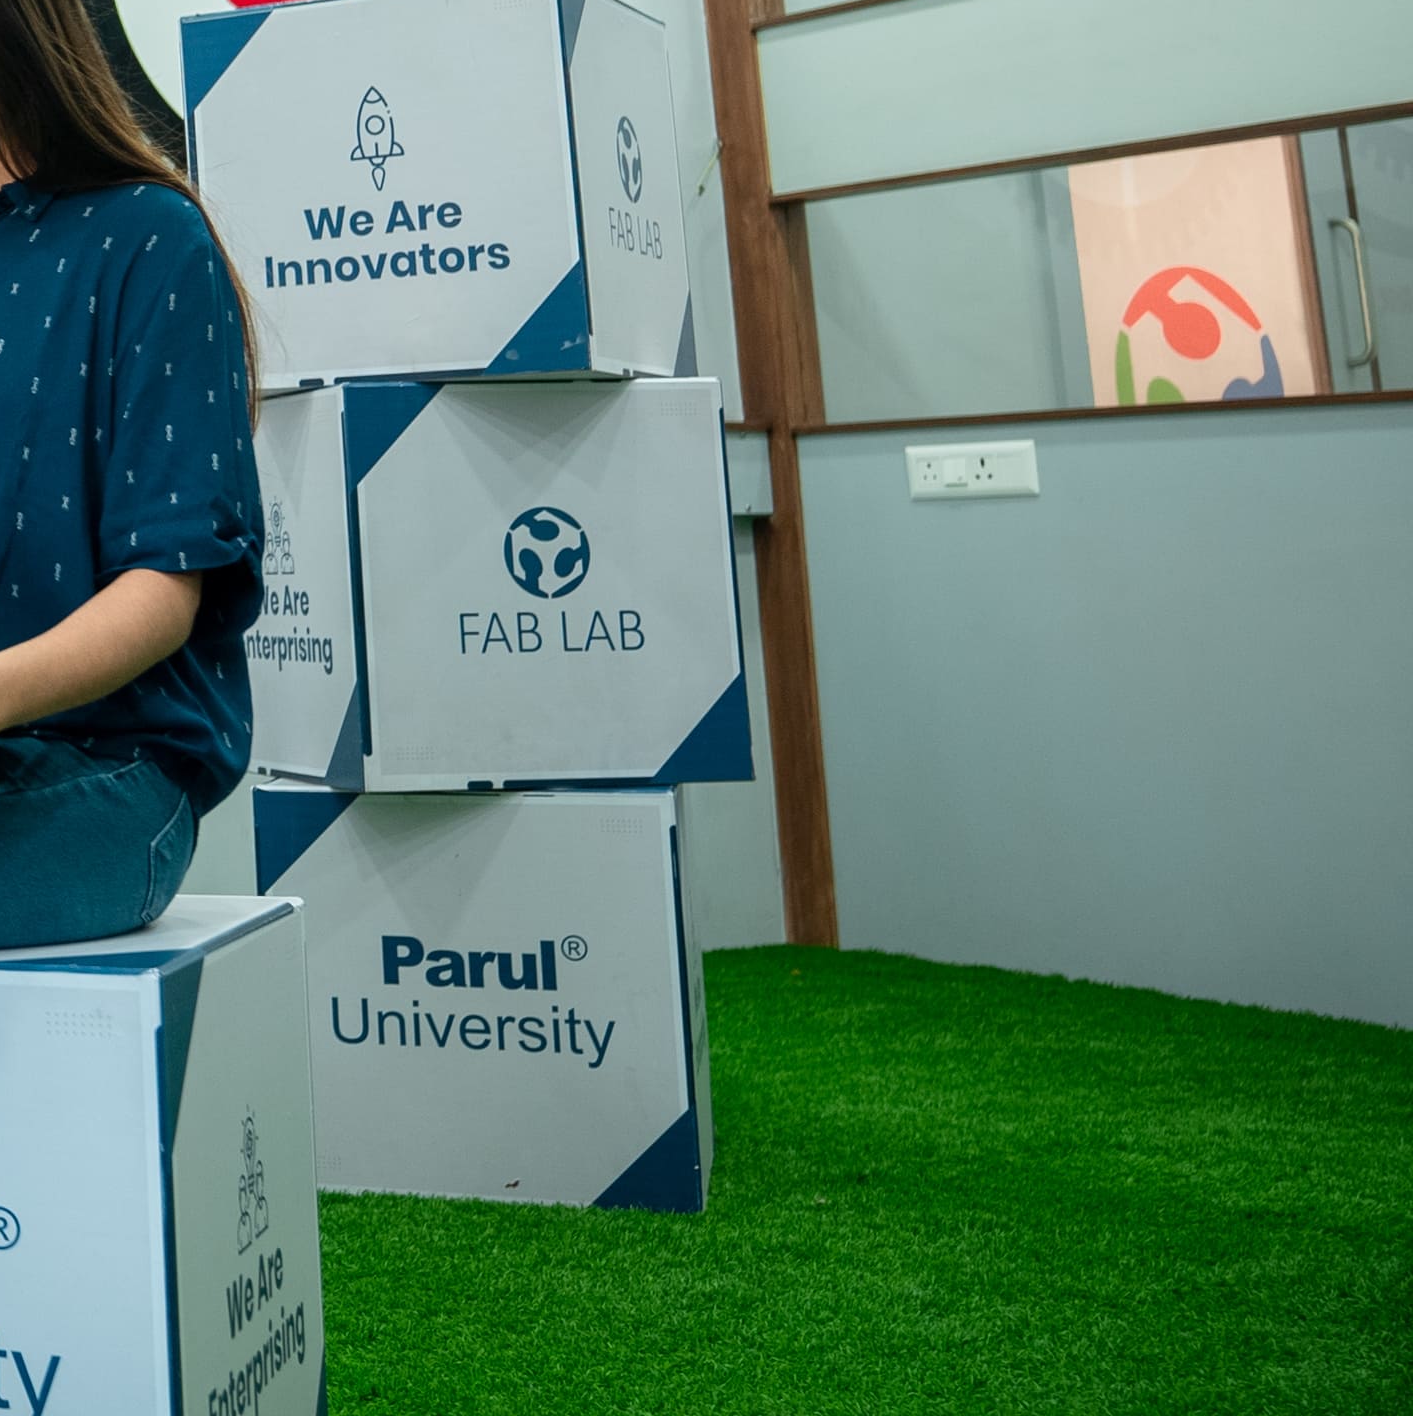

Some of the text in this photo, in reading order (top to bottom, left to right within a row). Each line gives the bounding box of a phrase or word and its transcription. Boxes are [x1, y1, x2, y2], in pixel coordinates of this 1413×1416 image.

[303, 200, 462, 241] We Are
[609, 207, 662, 259] FAB LAB
[265, 237, 511, 289] Innovators
[283, 585, 309, 616] Are
[246, 626, 333, 675] nterprising
[459, 610, 645, 654] FAB LAB
[331, 996, 616, 1069] University
[226, 1247, 283, 1339] We Are
